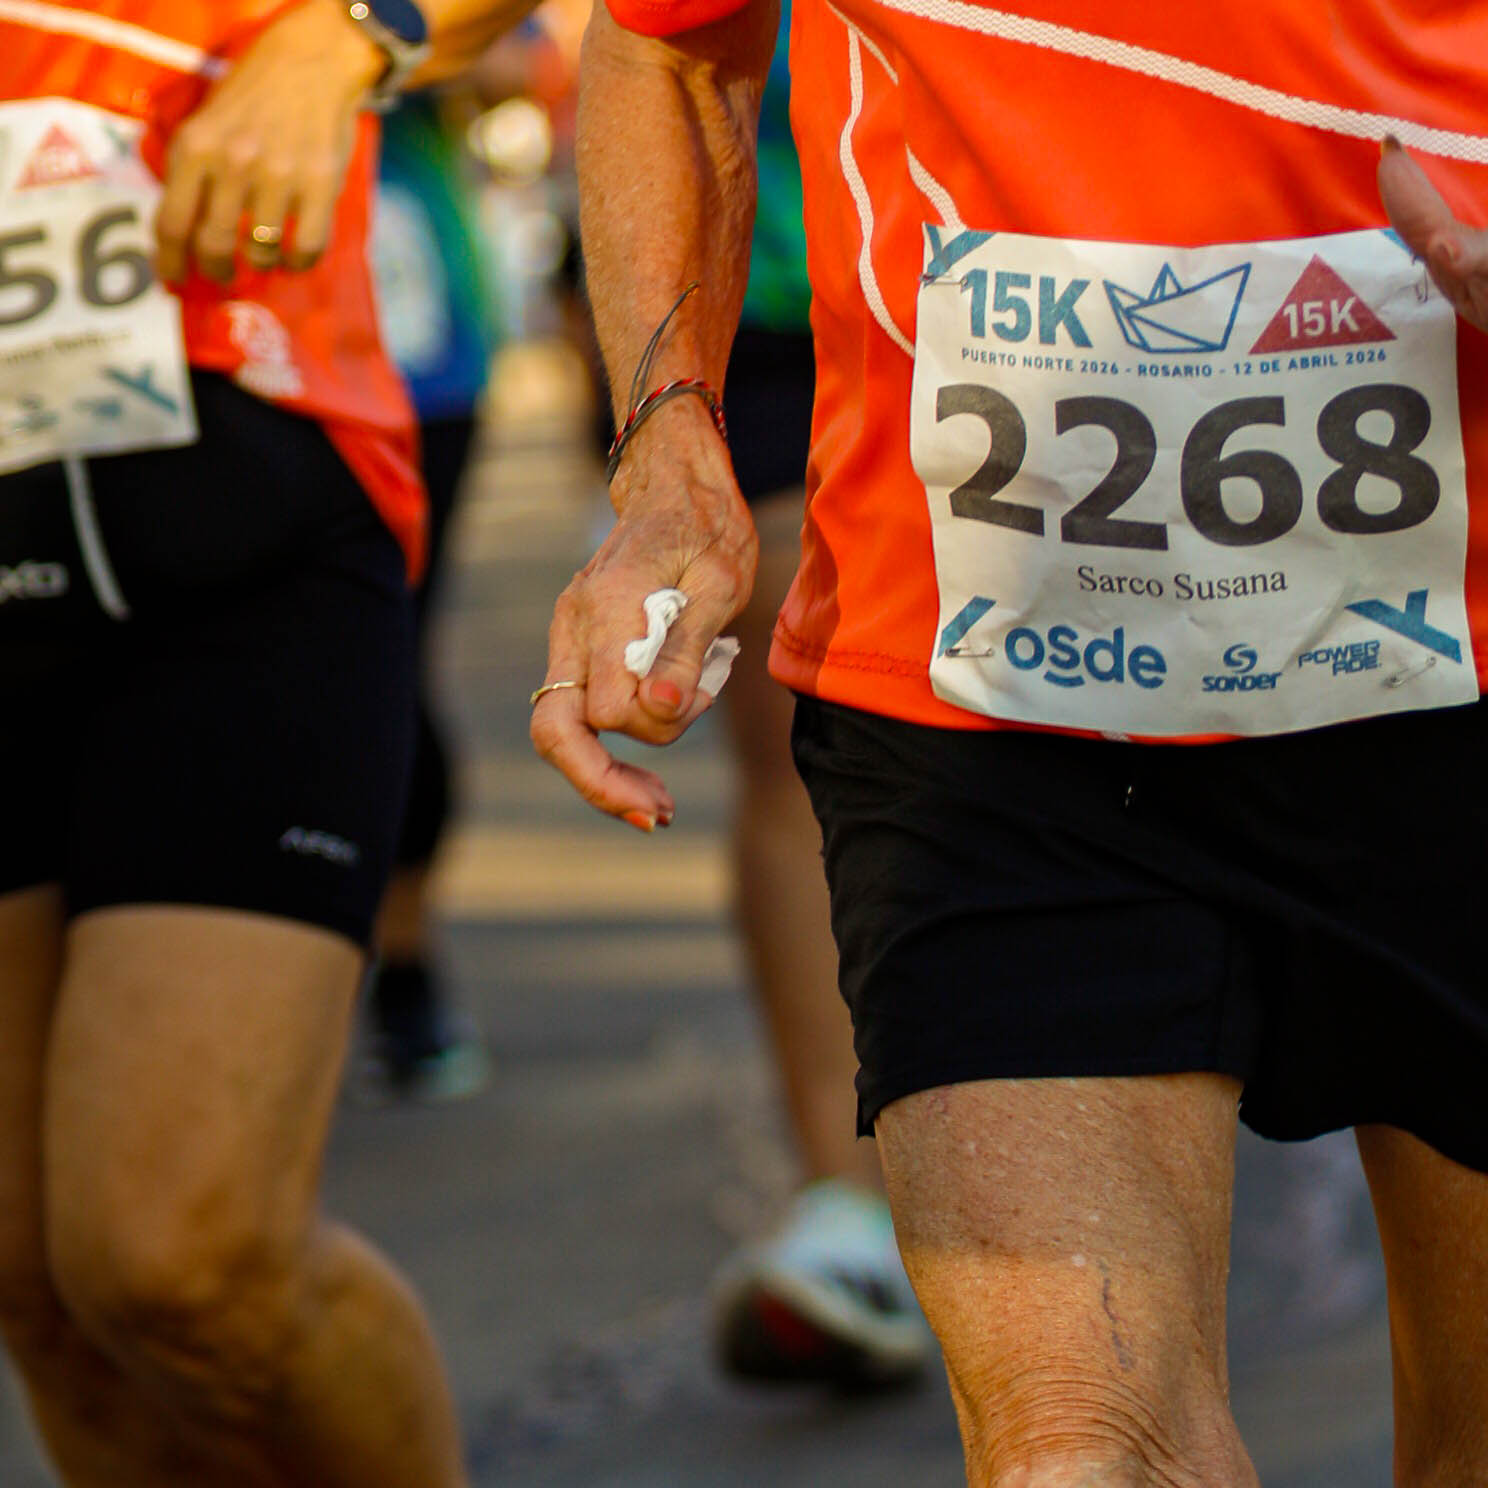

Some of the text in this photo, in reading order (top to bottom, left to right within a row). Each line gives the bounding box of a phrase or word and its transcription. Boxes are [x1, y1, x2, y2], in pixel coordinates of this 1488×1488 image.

[960, 268, 1093, 348] 15K
[1283, 296, 1360, 340] 15K
[961, 347, 1017, 368] PUERTO
[1023, 356, 1074, 373] NORTE
[1080, 361, 1119, 376] 2026
[1137, 364, 1212, 378] ROSARIO
[1233, 363, 1251, 376] 12
[1260, 360, 1280, 374] DE
[1288, 354, 1338, 371] ABRIL
[1346, 348, 1387, 365] 2026
[935, 383, 1441, 551] 2268
[1077, 565, 1288, 601] Sarco Susana
[1004, 624, 1167, 690] osde
[1299, 640, 1381, 669] POWER
